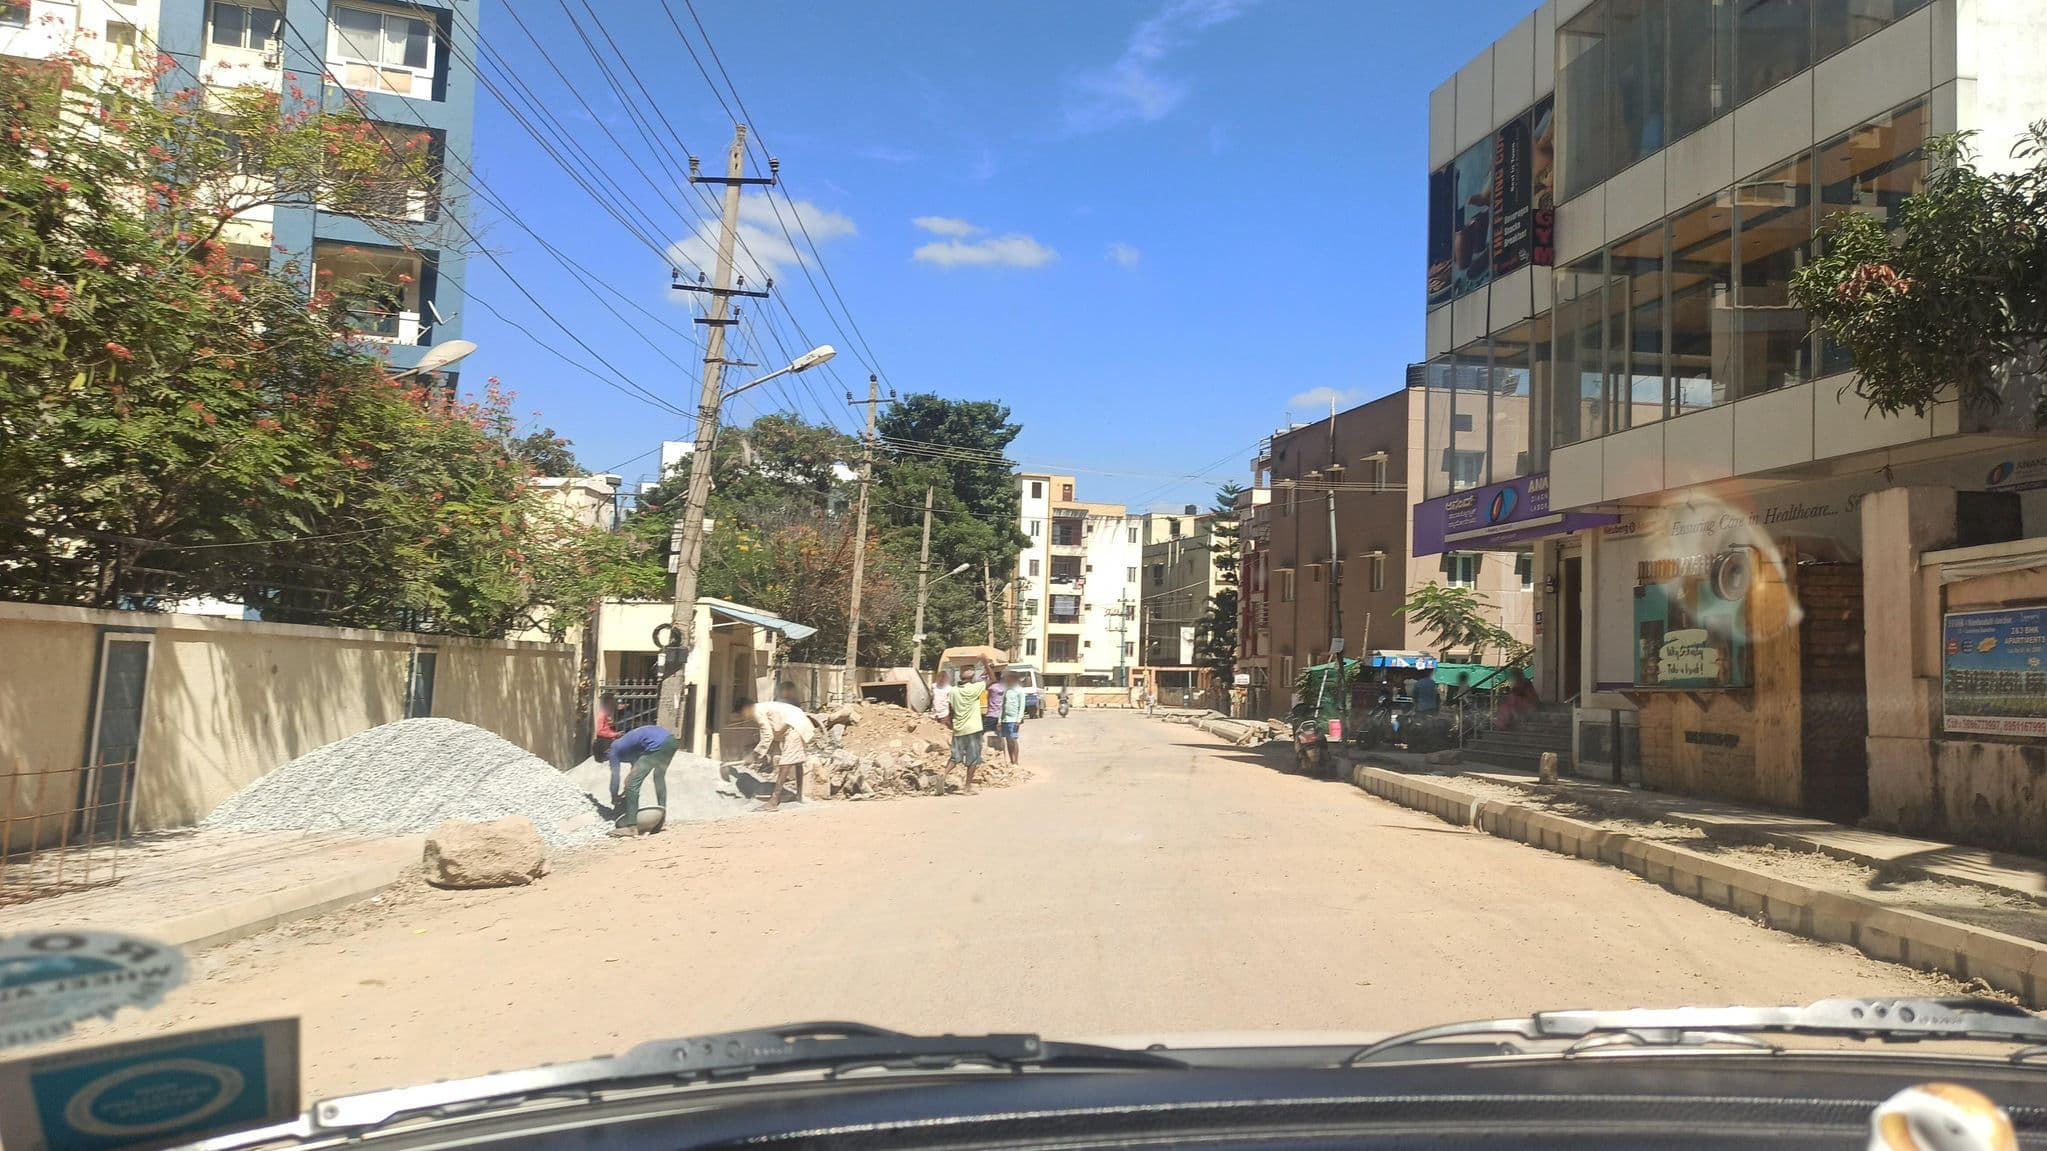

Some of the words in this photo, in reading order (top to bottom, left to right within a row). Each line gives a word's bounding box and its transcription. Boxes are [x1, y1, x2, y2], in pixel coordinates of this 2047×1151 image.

[1535, 211, 1553, 264] GYM
[1671, 520, 1716, 537] Ensuring
[1719, 511, 1745, 530] Care
[1749, 511, 1760, 526] in
